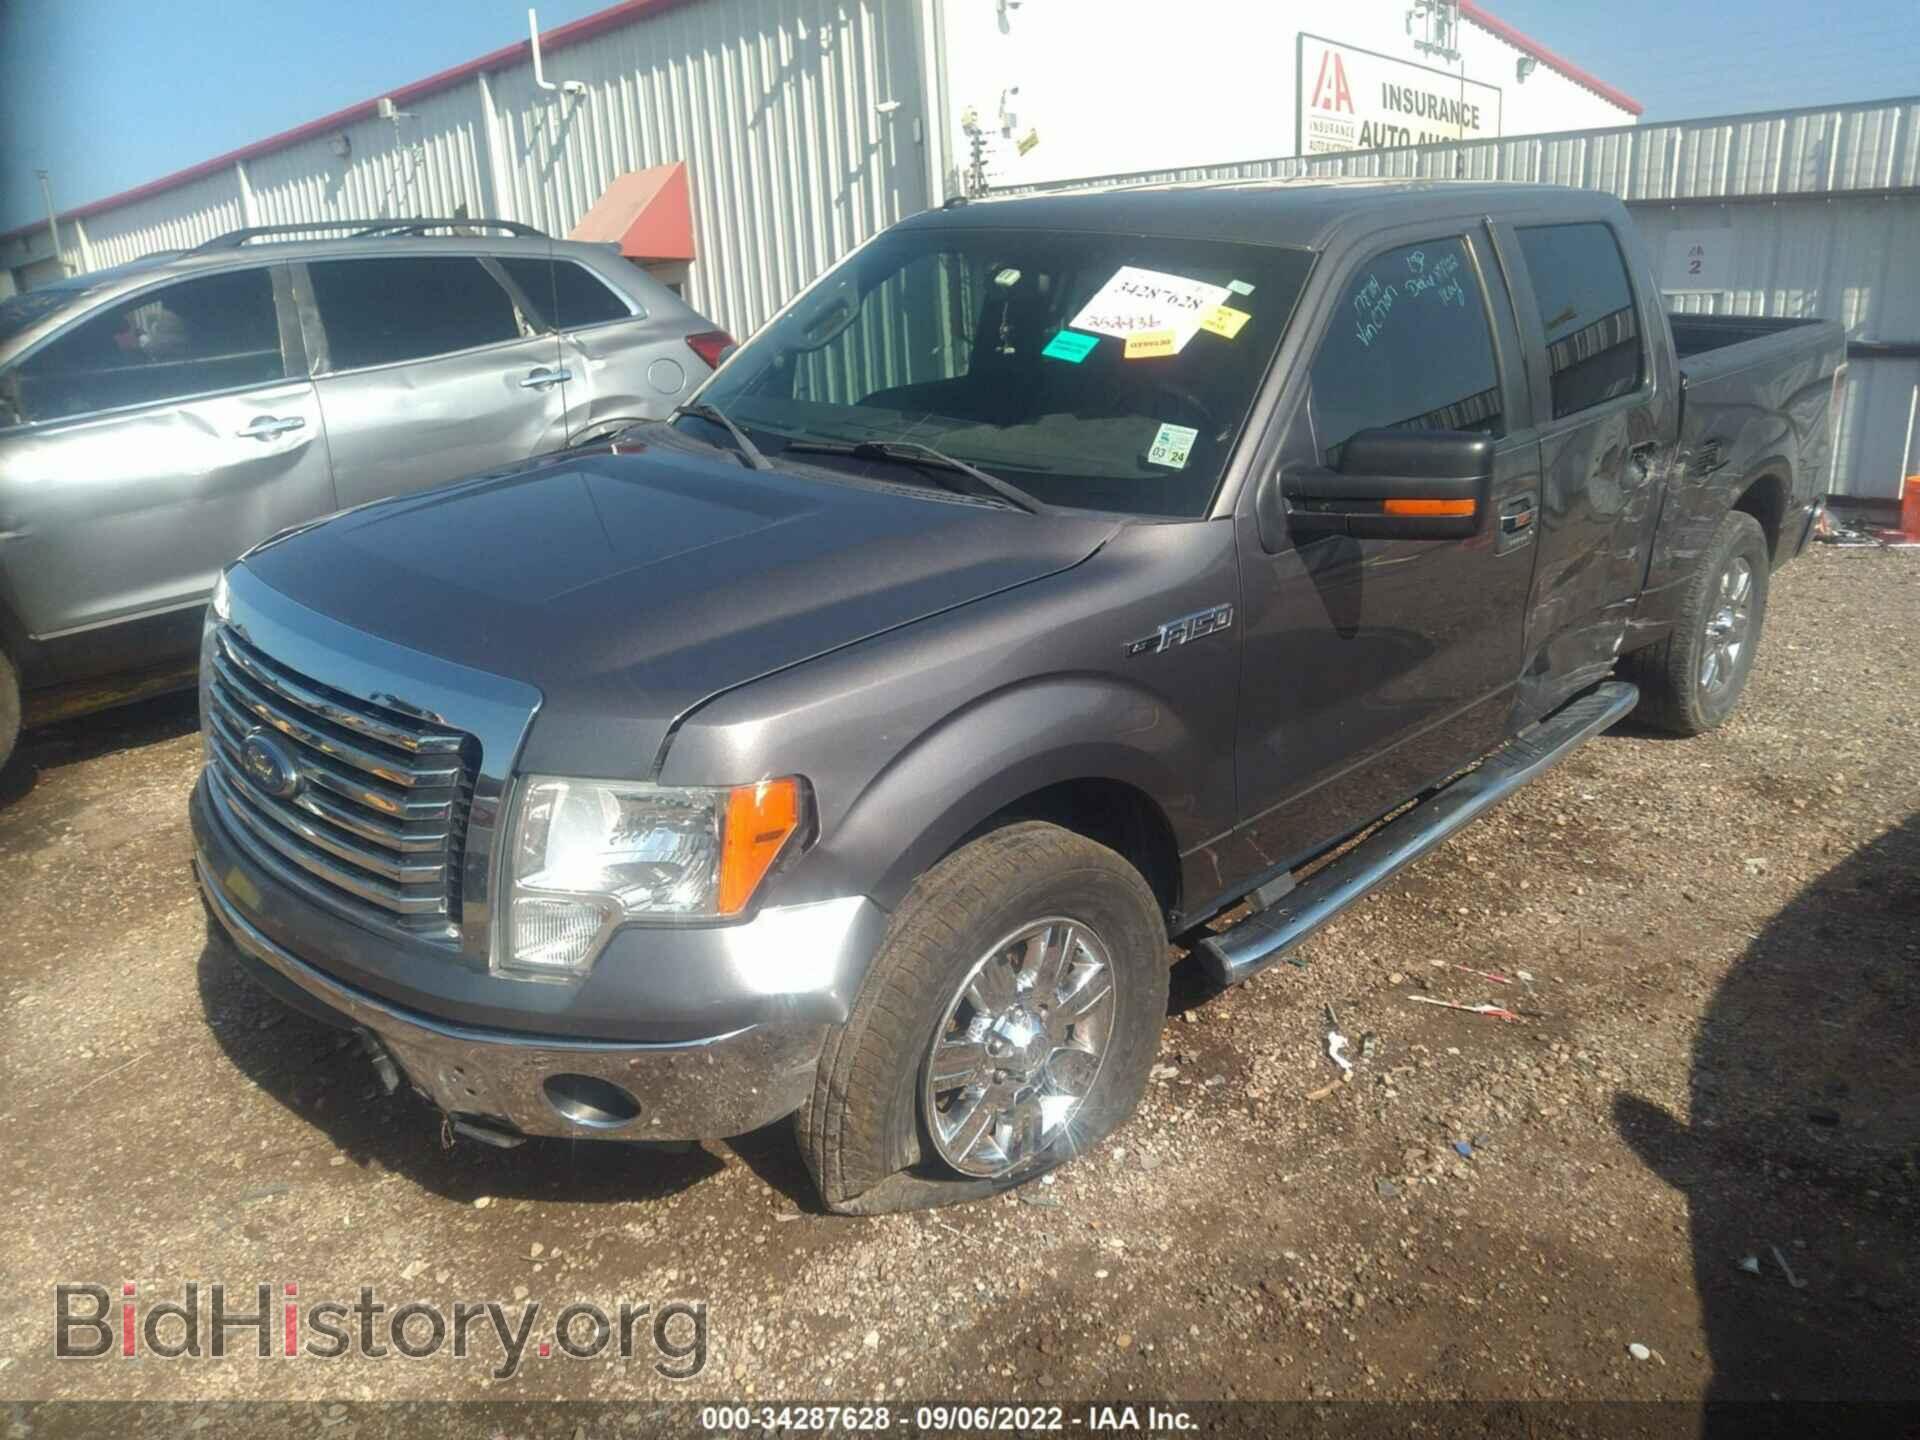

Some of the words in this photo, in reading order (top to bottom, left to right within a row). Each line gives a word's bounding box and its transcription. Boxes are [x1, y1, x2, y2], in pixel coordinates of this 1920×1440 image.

[1382, 82, 1480, 130] INSURANCE
[1310, 120, 1356, 139] INSURANCE
[1358, 120, 1411, 149] AUTO
[1688, 260, 1702, 275] 2
[1152, 447, 1167, 458] 03
[1170, 451, 1185, 462] 24
